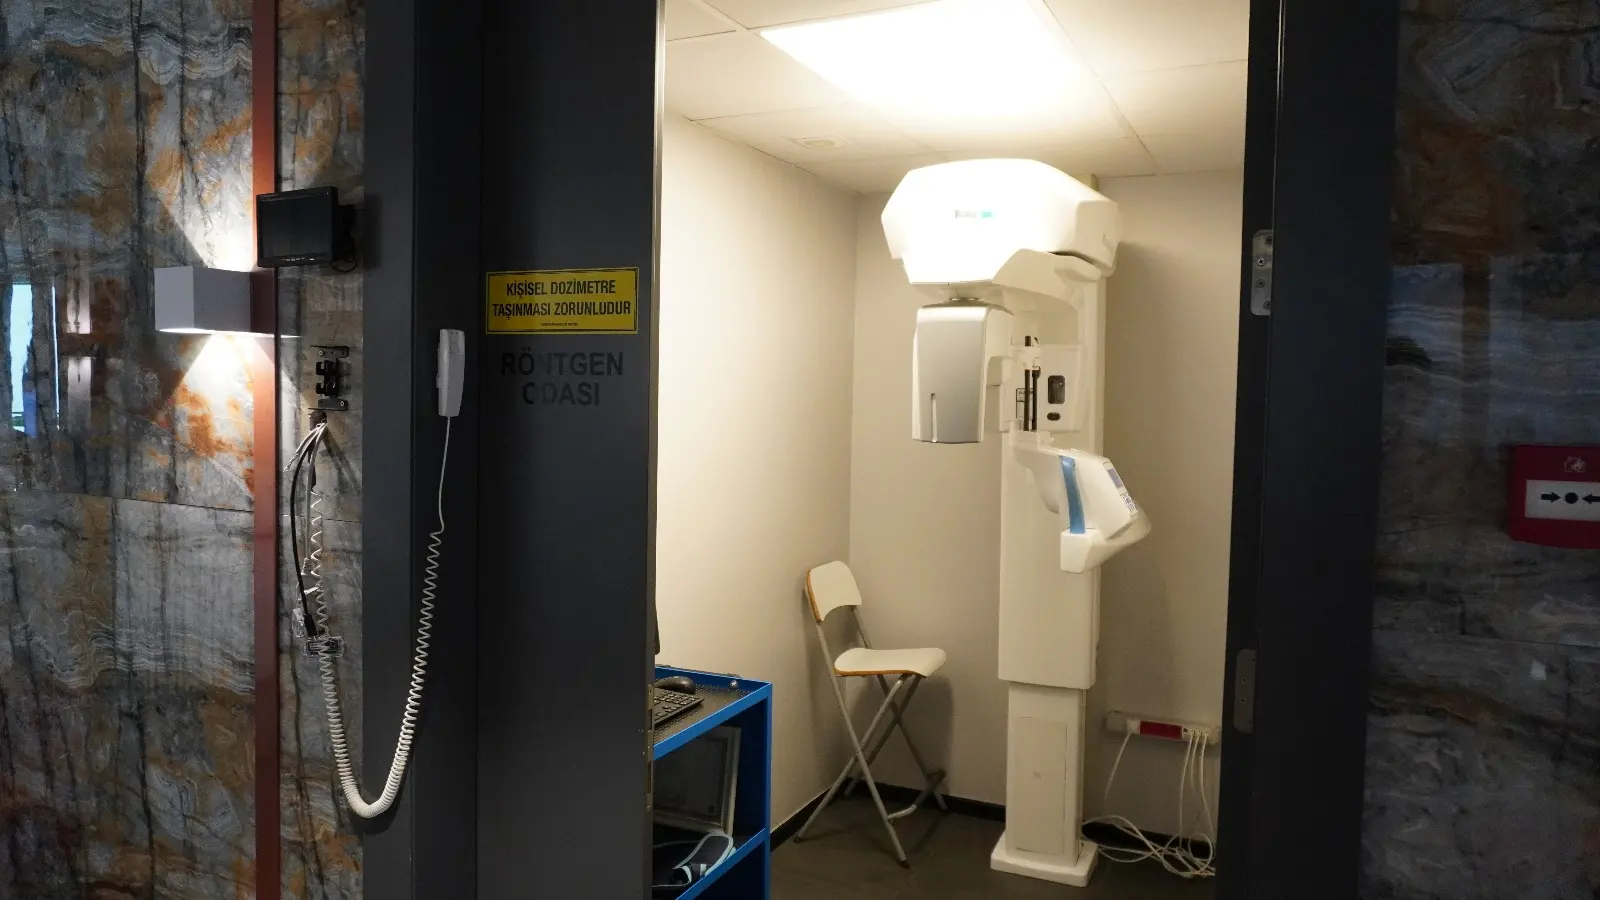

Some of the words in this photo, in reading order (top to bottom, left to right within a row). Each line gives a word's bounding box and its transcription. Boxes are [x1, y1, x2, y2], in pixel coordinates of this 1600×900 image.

[506, 280, 547, 299] KİŞİSEL
[550, 278, 616, 295] DOZİMETRE
[492, 302, 551, 320] TAŞINMASI
[553, 301, 631, 316] ZORUNLUDUR
